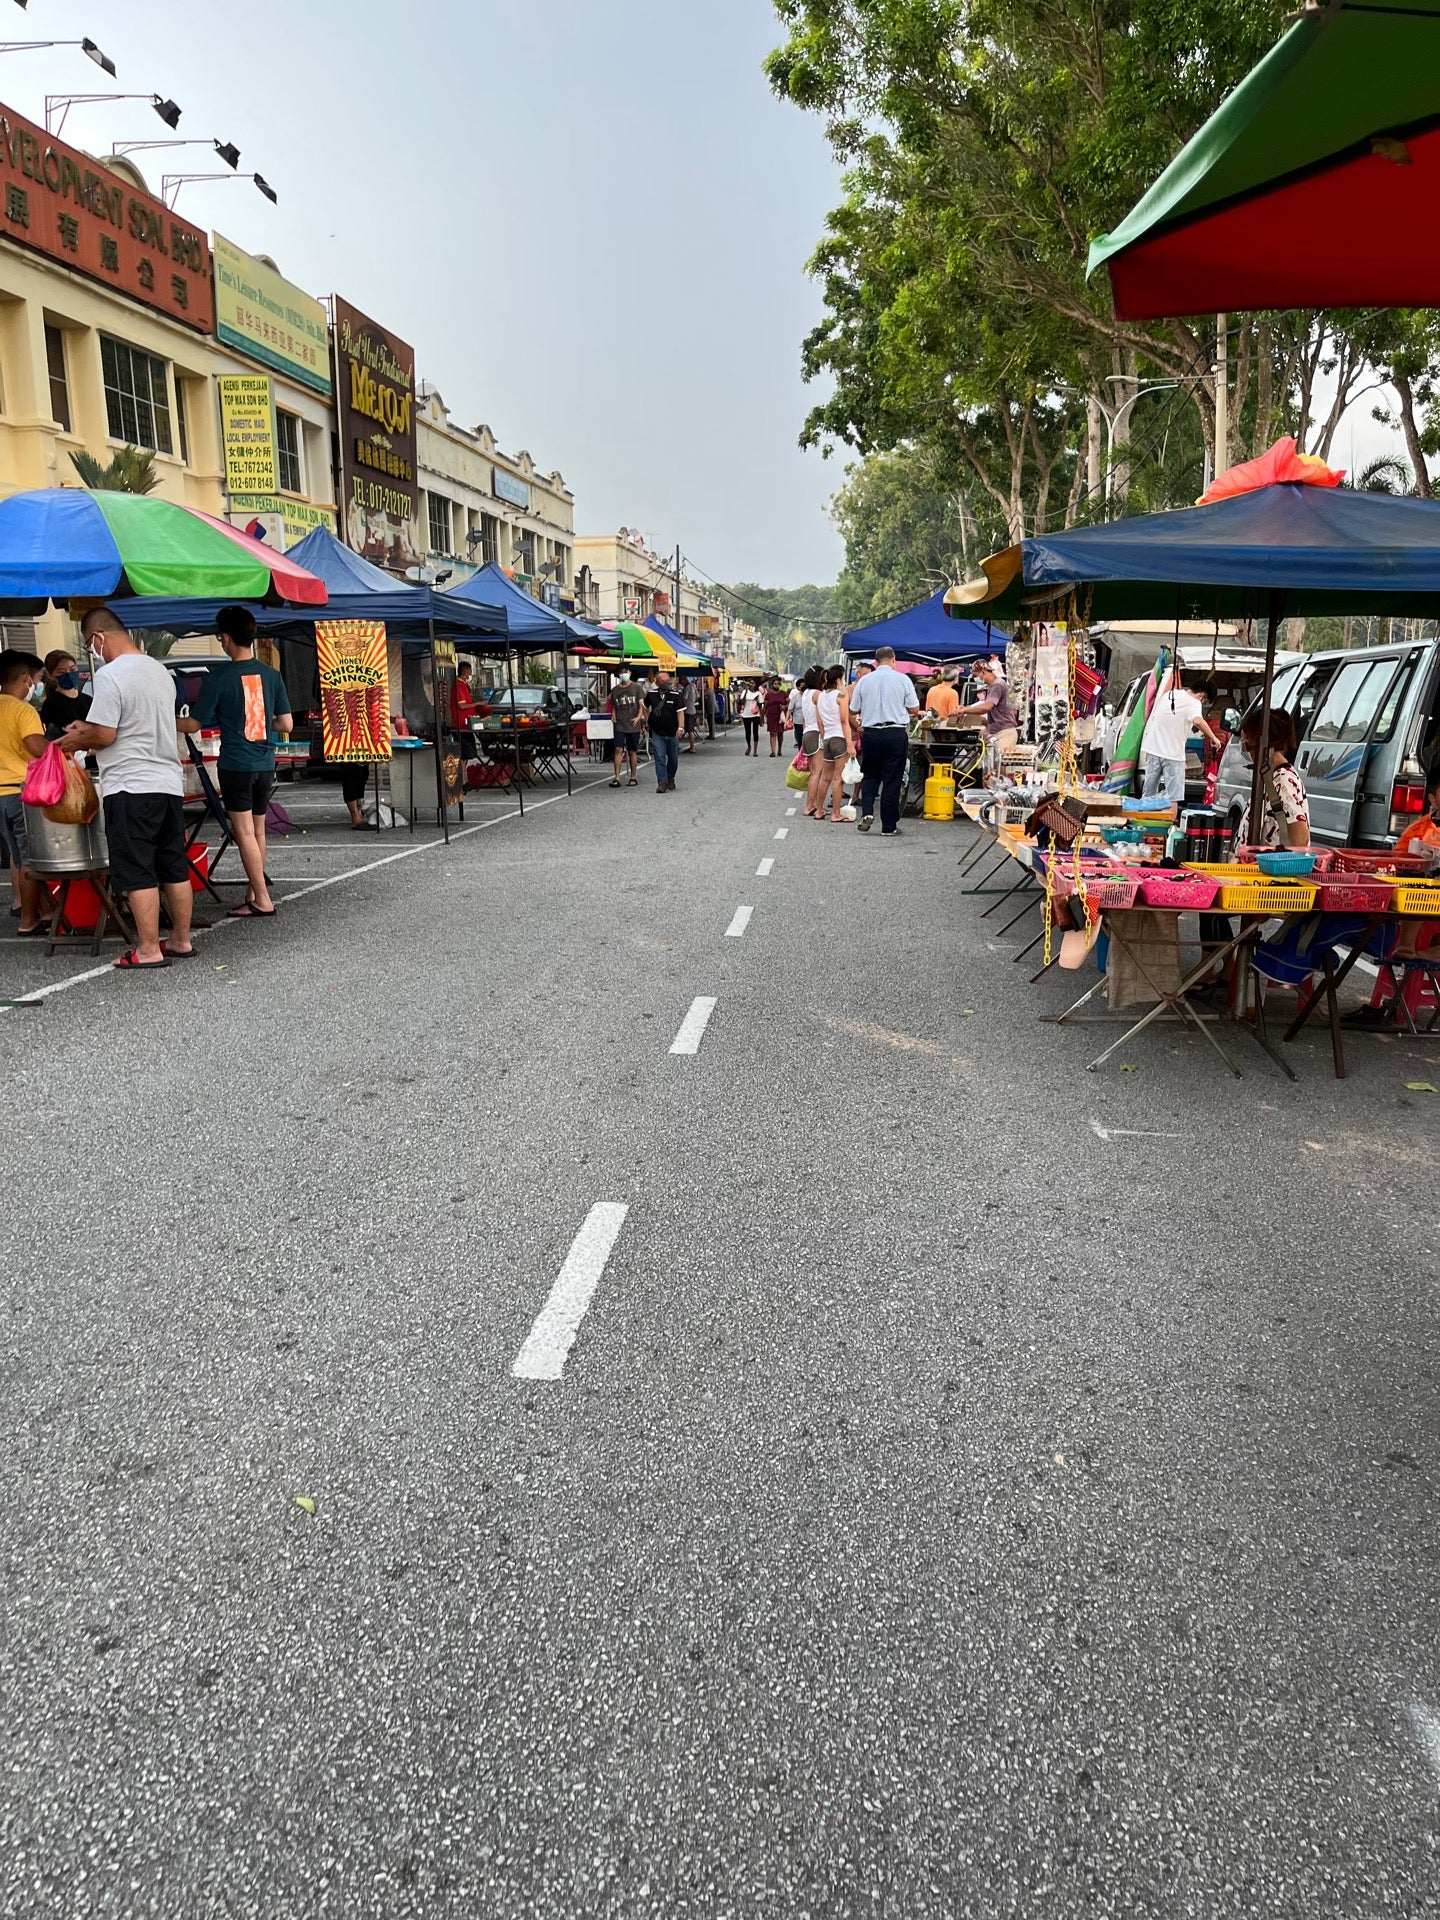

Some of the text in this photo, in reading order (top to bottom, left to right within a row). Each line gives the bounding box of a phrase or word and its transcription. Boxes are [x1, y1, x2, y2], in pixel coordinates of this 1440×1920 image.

[0, 115, 123, 229] VELOPMENT
[128, 198, 168, 256] SDN.
[224, 394, 268, 406] TOP MAX SDN BHD
[230, 419, 252, 429] DOMESTIC
[226, 433, 271, 443] LOCAL EMPLOYMENT
[286, 503, 296, 519] TOP
[323, 665, 383, 681] CHICKEN
[329, 675, 376, 687] WINGS
